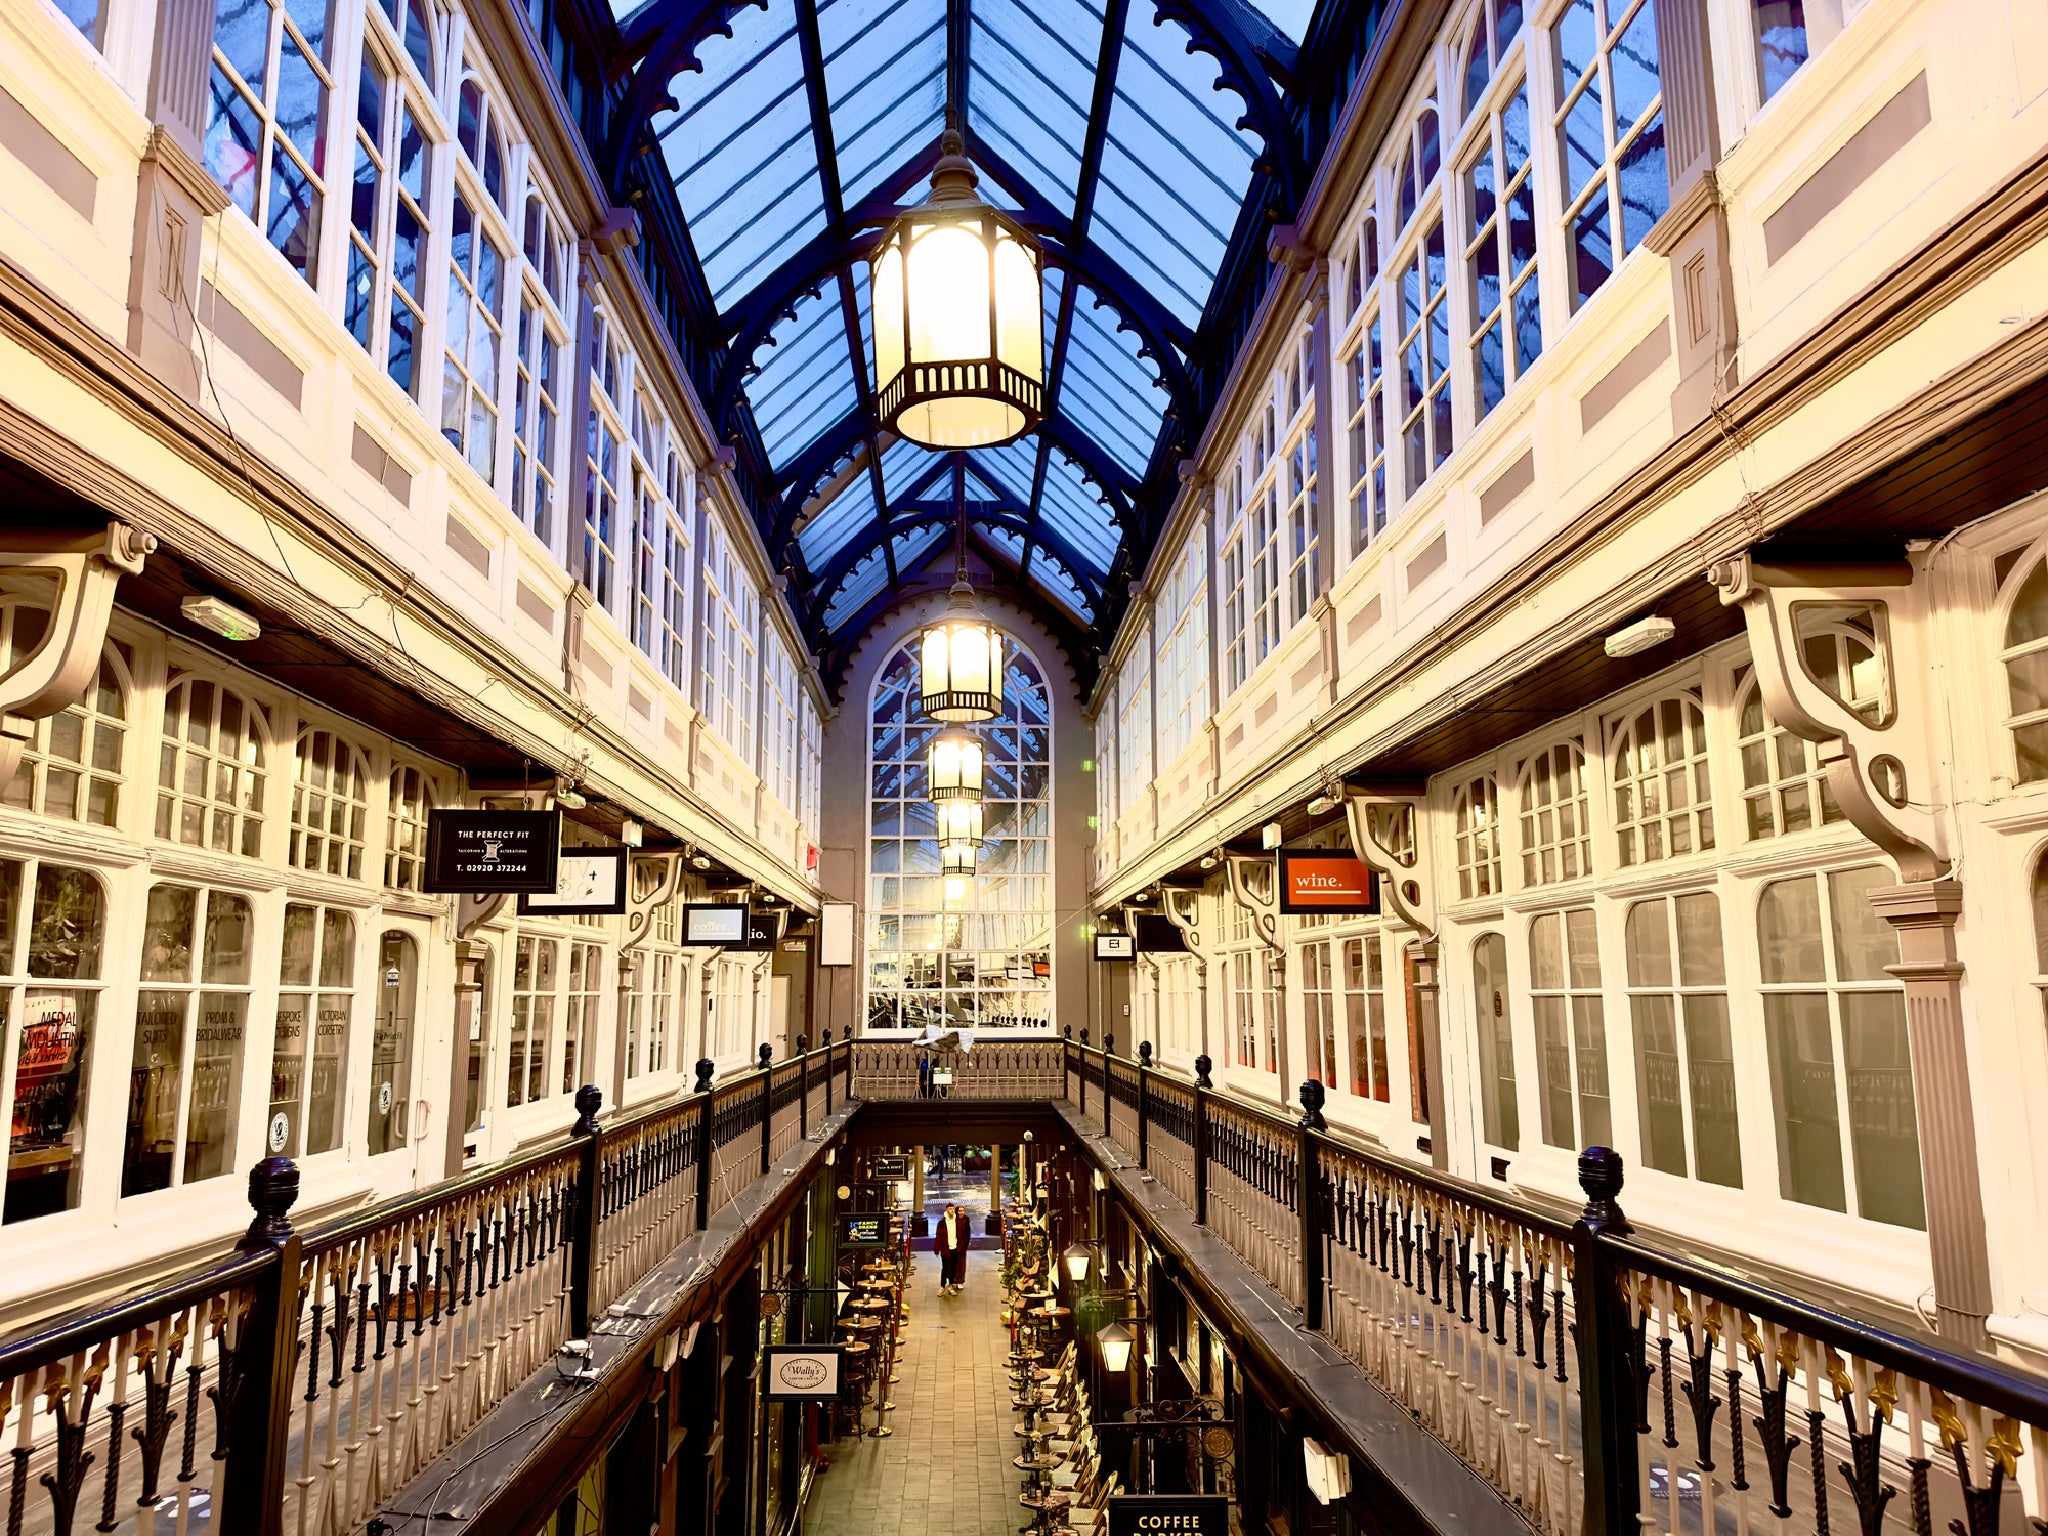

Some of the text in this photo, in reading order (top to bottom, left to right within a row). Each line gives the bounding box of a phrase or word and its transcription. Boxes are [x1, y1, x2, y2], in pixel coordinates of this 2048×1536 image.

[458, 830, 530, 839] THE PERFECT FIT
[496, 864, 527, 872] 372244
[1296, 872, 1342, 887] wine.
[694, 921, 730, 931] coffee.
[750, 928, 767, 939] io.
[41, 1011, 77, 1027] MEDAL
[136, 1011, 177, 1026] TAILORED
[205, 1011, 227, 1024] PROM
[318, 1010, 347, 1021] VICTORIAN
[195, 1027, 242, 1041] BRIDALWEAR
[317, 1024, 345, 1036] CORSETRY
[143, 1029, 168, 1044] SUITS
[787, 1366, 820, 1378] Wally's
[1138, 1515, 1200, 1529] COFFEE
